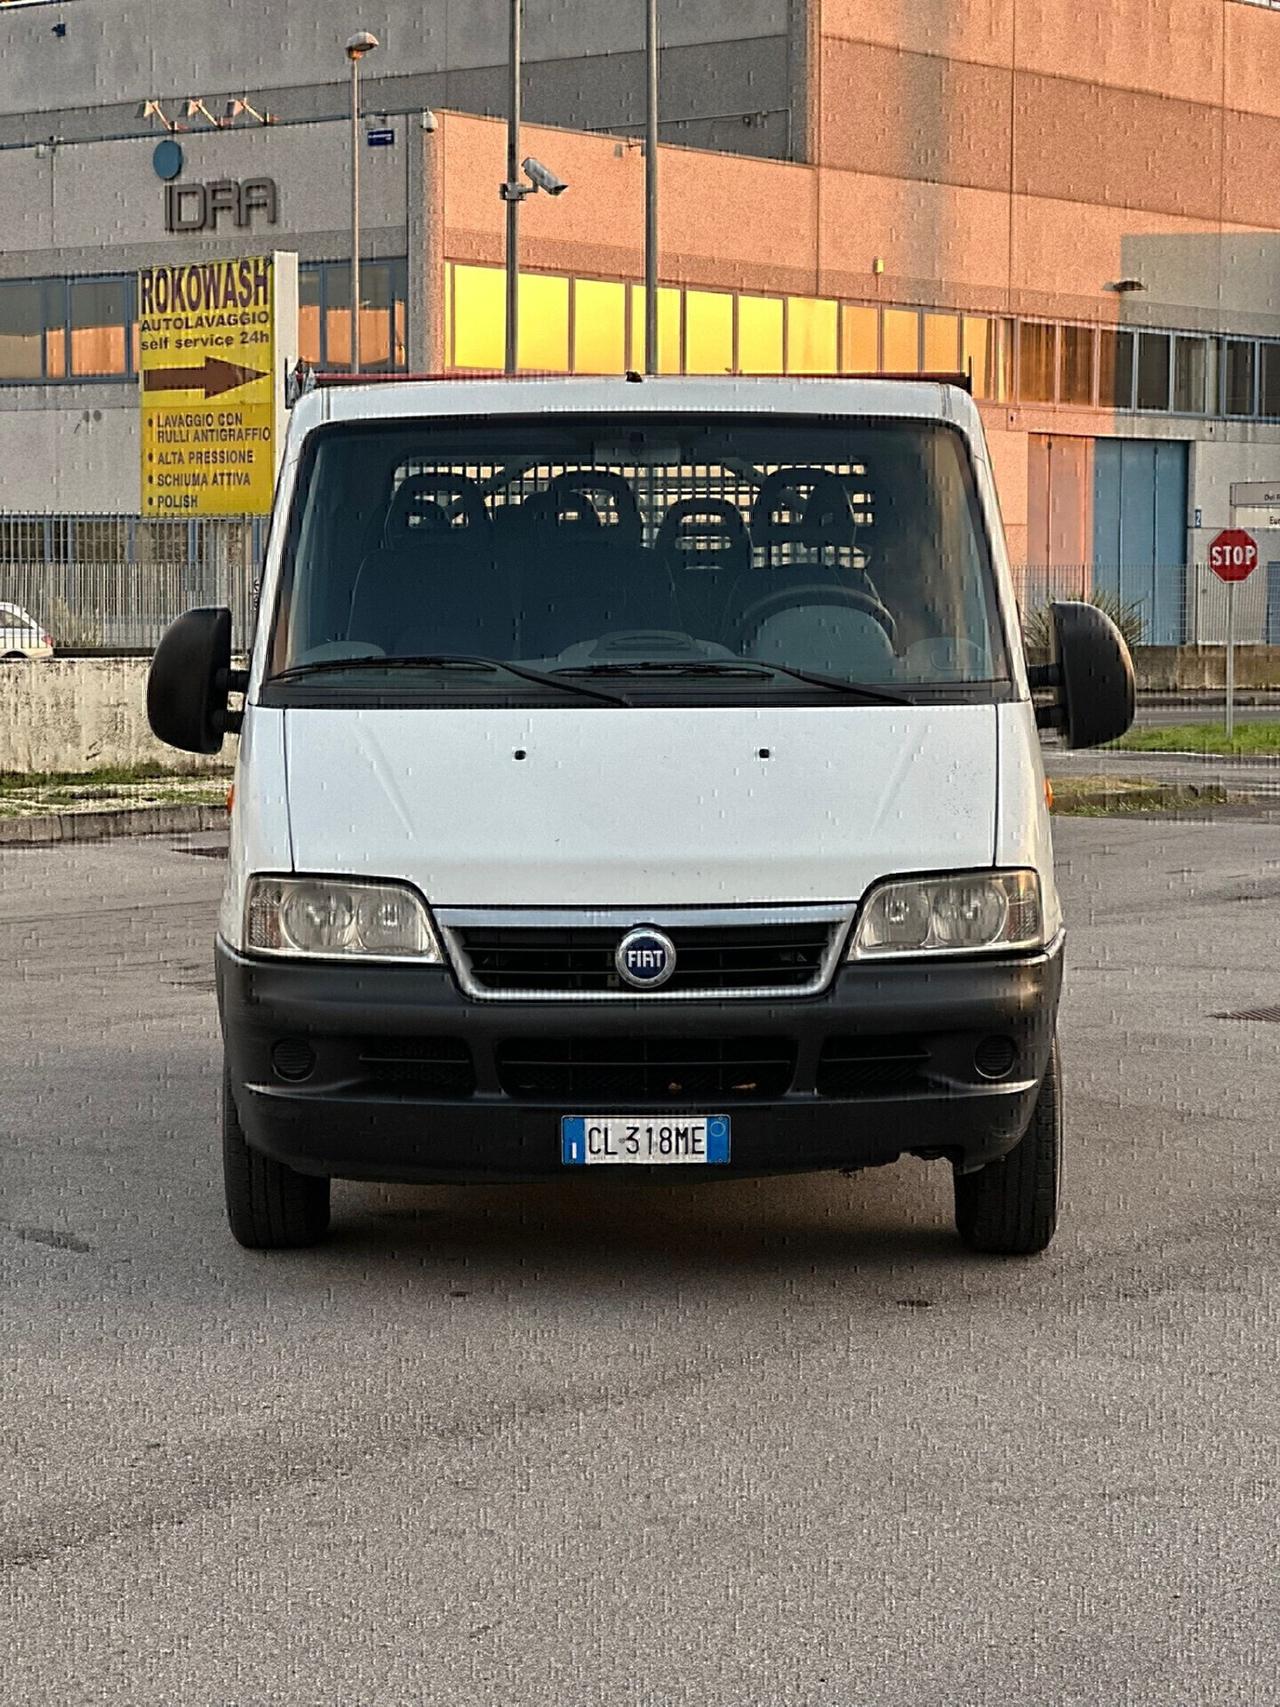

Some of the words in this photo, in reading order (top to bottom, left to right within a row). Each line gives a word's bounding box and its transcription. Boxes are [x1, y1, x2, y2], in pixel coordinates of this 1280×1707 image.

[164, 176, 277, 232] IDRA
[141, 258, 269, 315] ROKOWASH
[140, 311, 270, 333] AUTOLAVAGGIO
[140, 337, 169, 351] self
[175, 334, 235, 349] service
[240, 331, 270, 345] 24h
[157, 413, 214, 428] LAVAGGIO
[217, 412, 243, 426] CON
[157, 428, 190, 443] RULLI
[192, 426, 271, 443] ANTIGRAFFIO
[157, 451, 186, 465] ALTA
[188, 450, 254, 464] PRESSIONE
[157, 473, 209, 487] SCHIUMA
[211, 472, 251, 486] ATTIVA
[157, 494, 198, 509] POLISH
[1211, 545, 1256, 567] STOP
[627, 950, 664, 968] FIAT
